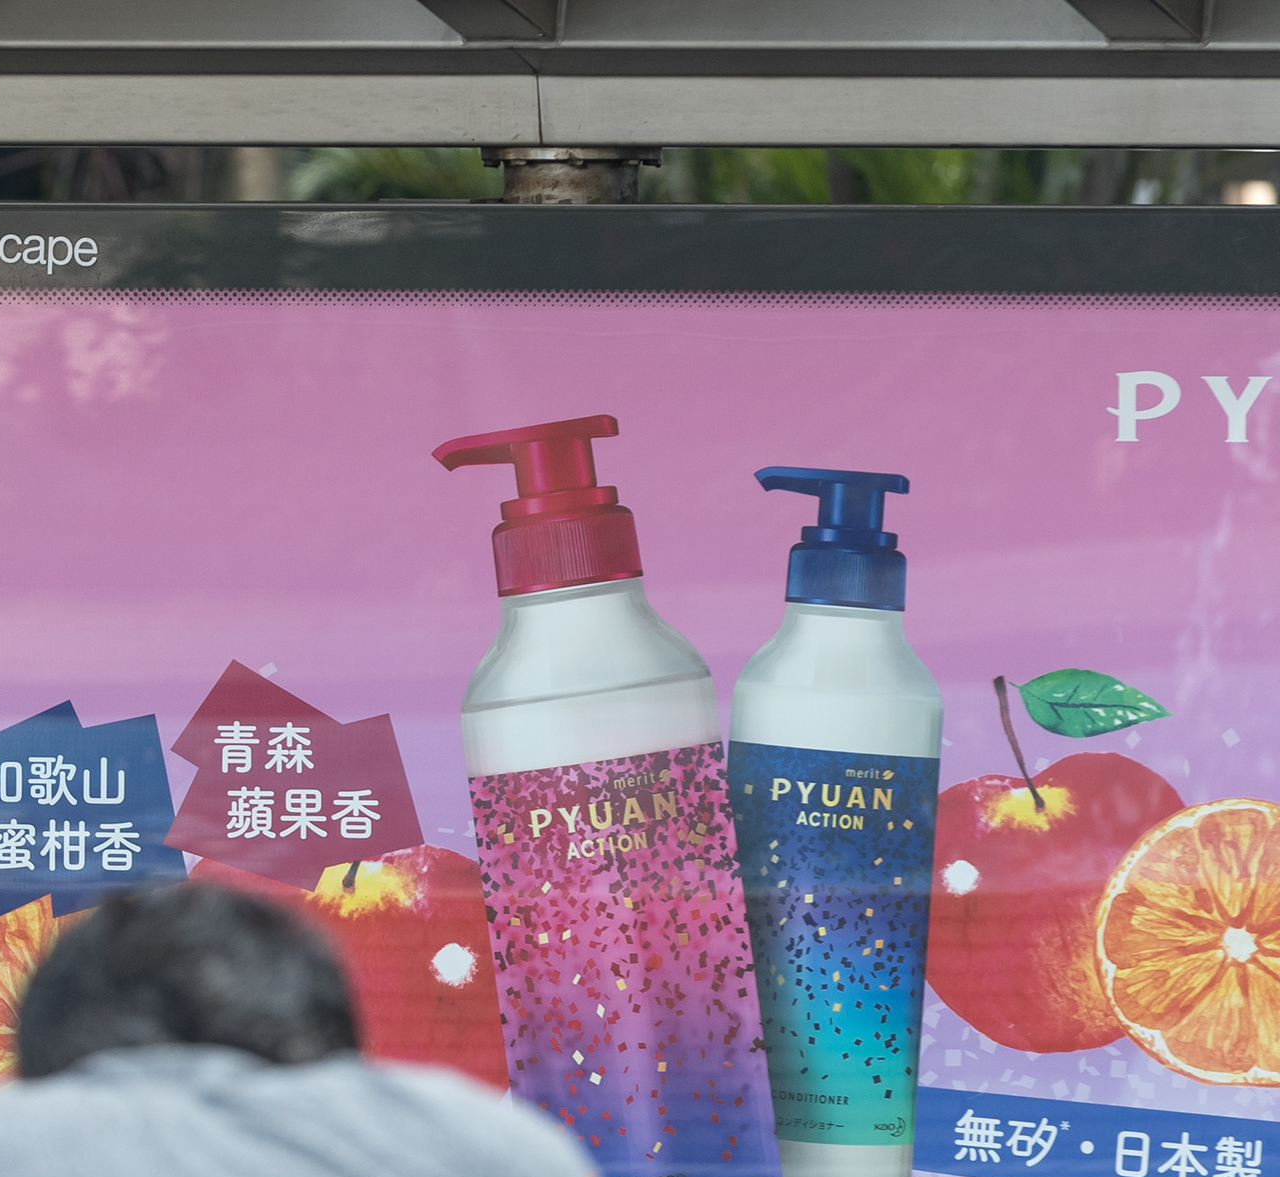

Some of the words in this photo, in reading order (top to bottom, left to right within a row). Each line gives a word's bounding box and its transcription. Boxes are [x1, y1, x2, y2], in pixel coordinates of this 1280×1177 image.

[1106, 370, 1274, 443] PY
[214, 720, 314, 774] 青森
[613, 771, 657, 790] merit
[845, 768, 880, 780] merit
[769, 777, 893, 811] PYUAN
[226, 786, 381, 840] 蘋果香
[528, 790, 678, 839] PYUAN
[795, 811, 864, 830] ACTION
[567, 831, 648, 860] ACTION
